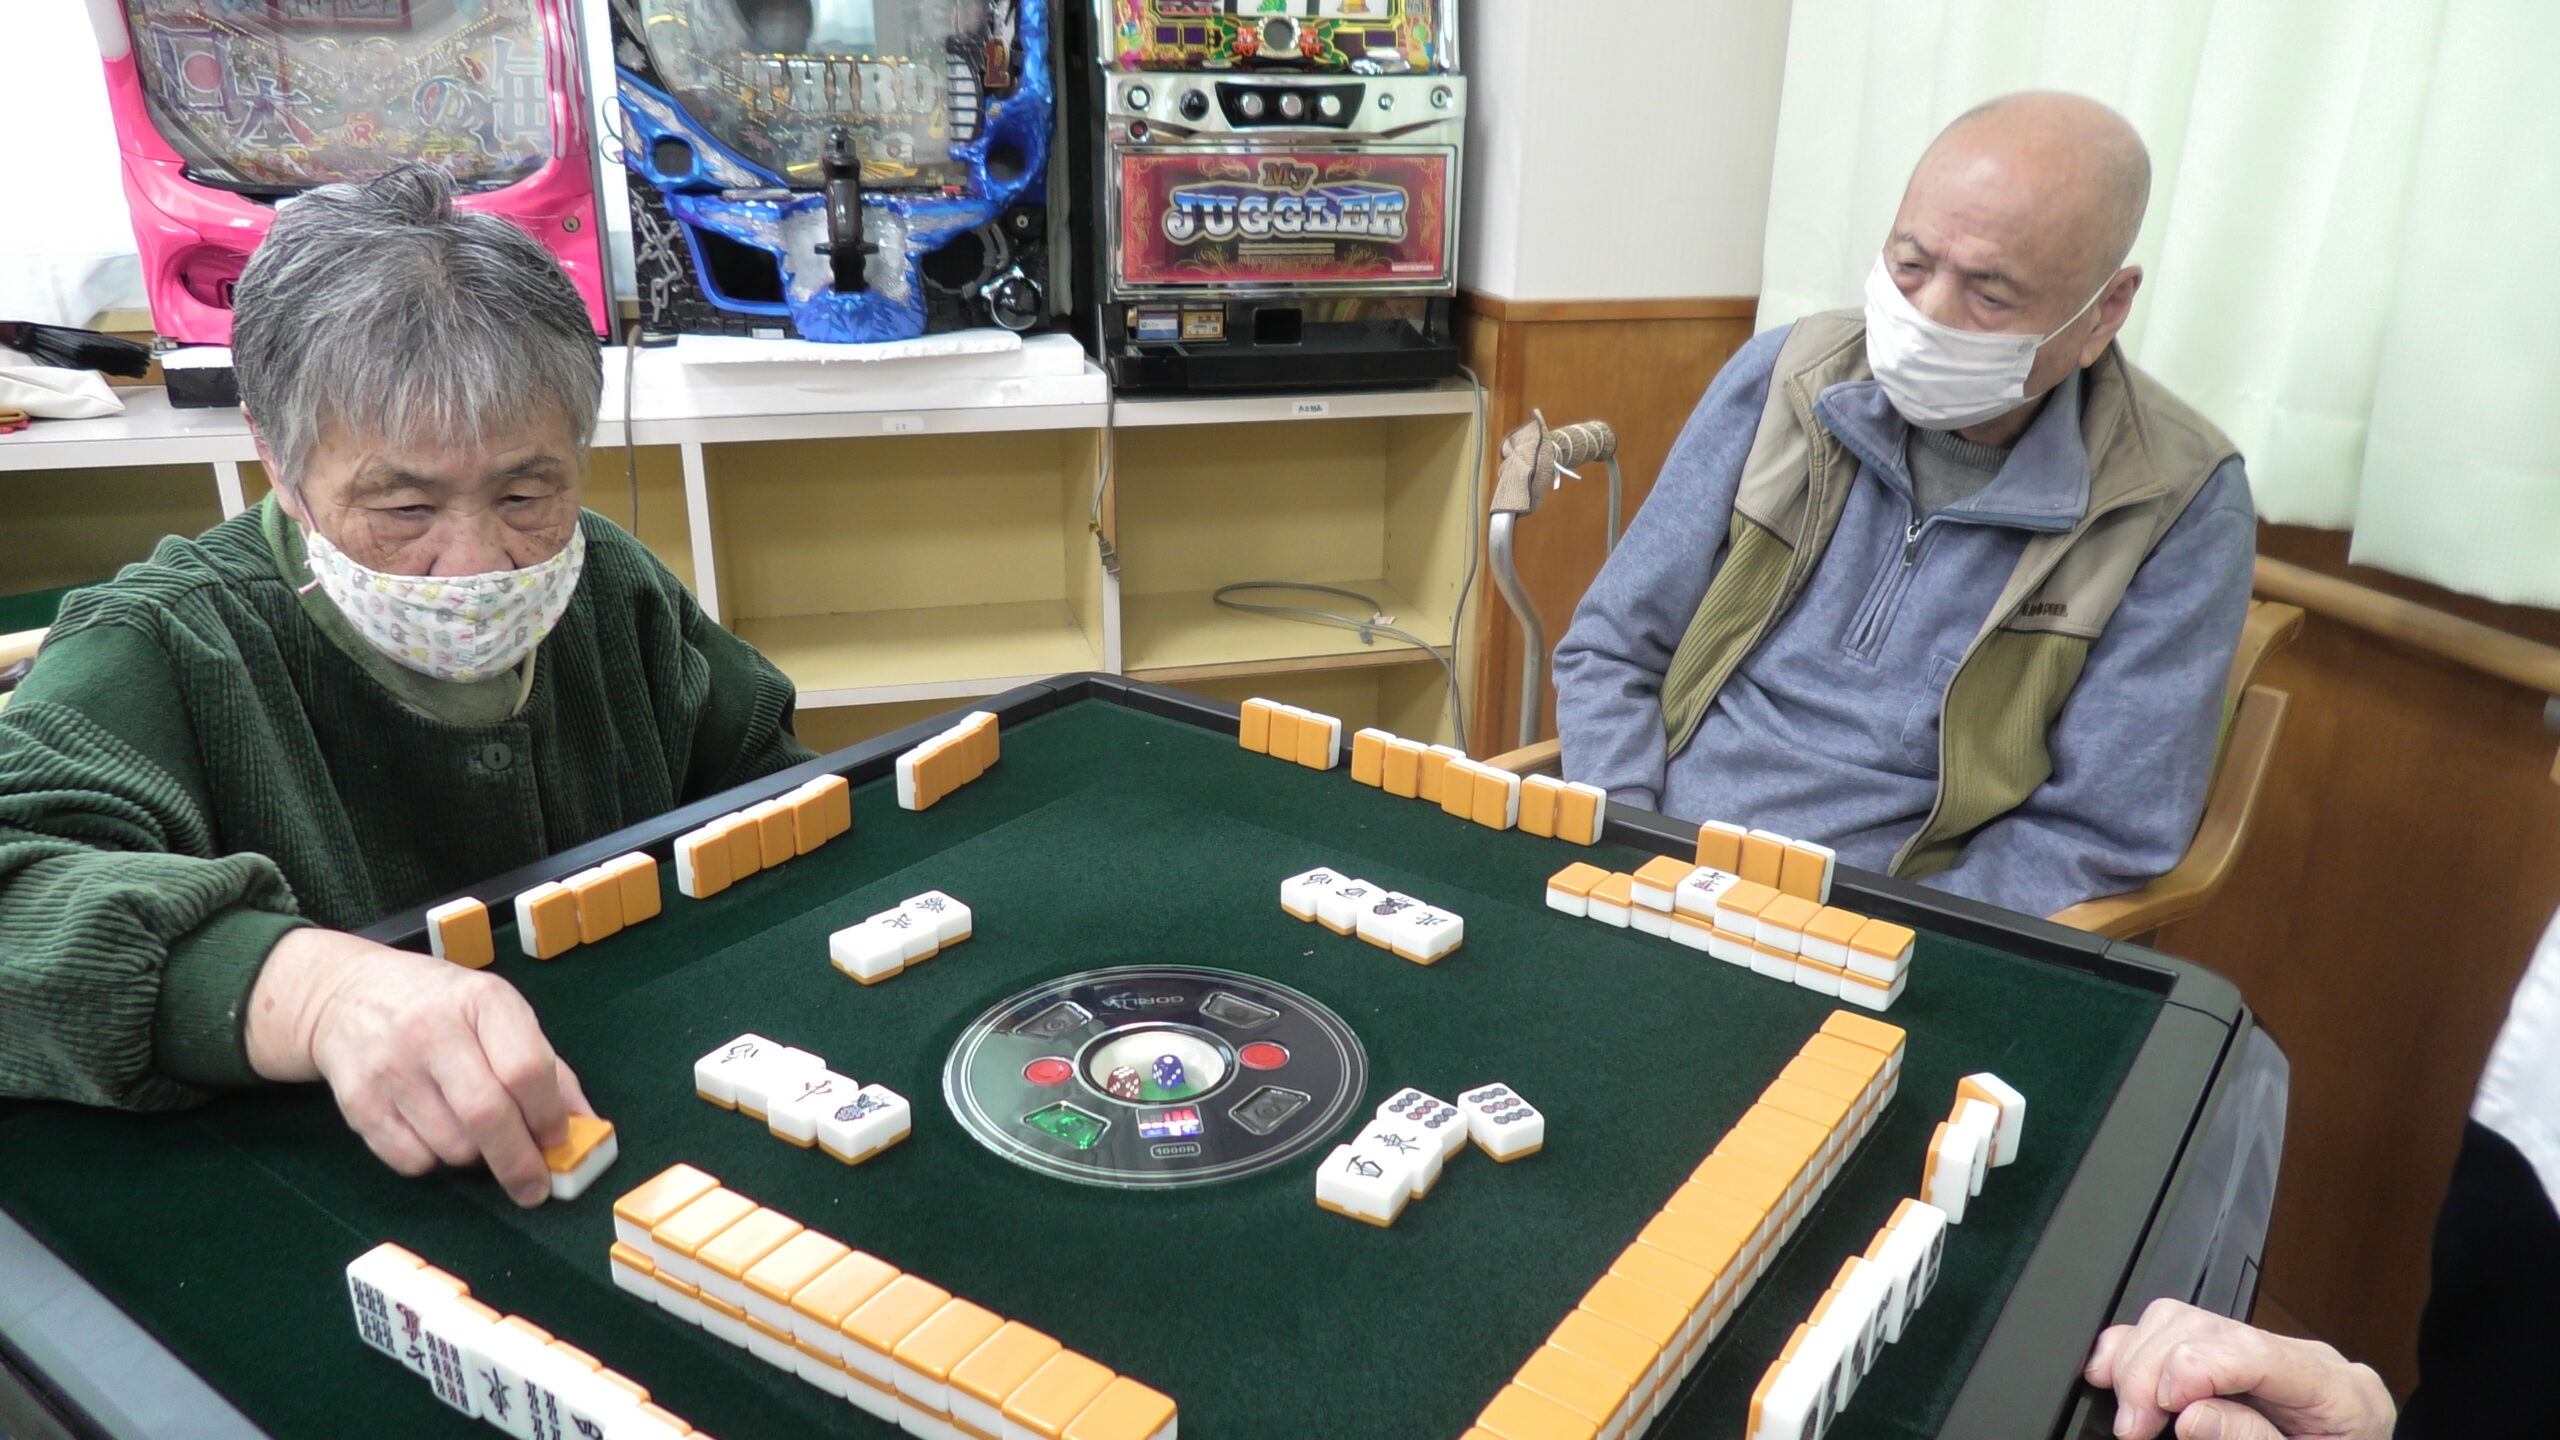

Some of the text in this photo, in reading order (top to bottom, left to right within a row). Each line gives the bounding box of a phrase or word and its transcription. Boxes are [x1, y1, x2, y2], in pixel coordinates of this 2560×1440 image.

[741, 59, 938, 114] THIRD
[1262, 161, 1313, 190] My
[1166, 191, 1405, 239] JUGGLER
